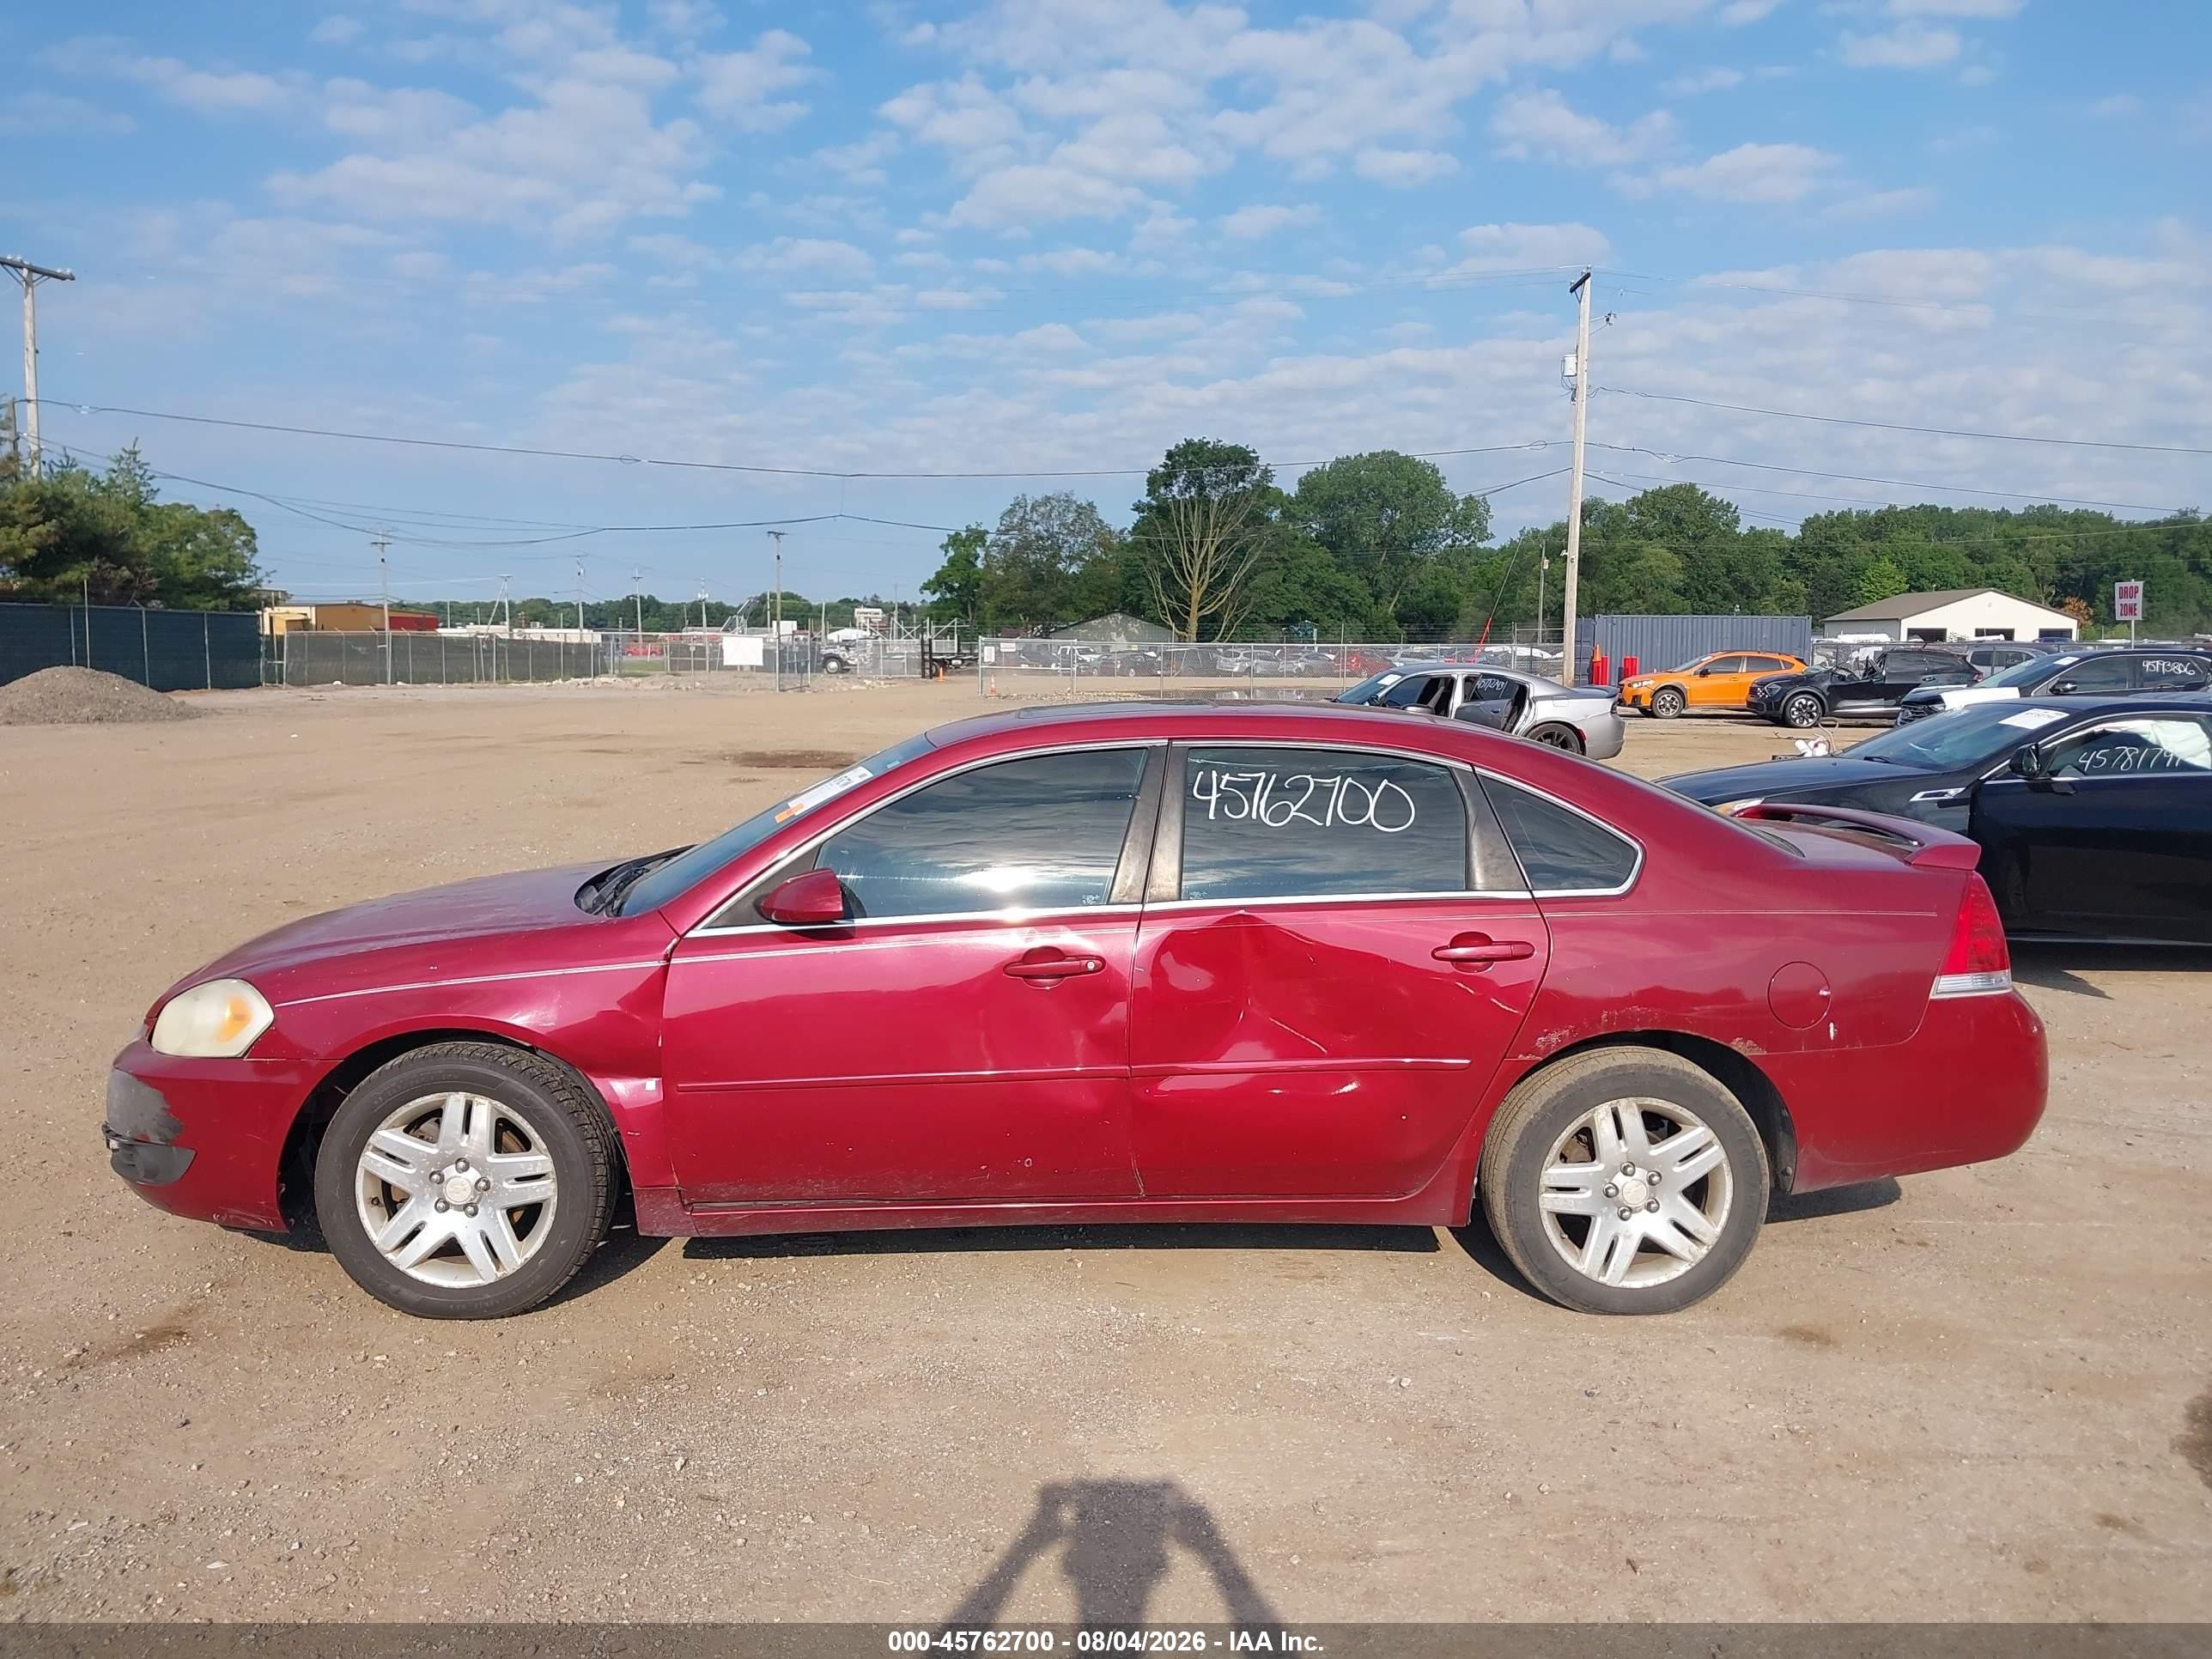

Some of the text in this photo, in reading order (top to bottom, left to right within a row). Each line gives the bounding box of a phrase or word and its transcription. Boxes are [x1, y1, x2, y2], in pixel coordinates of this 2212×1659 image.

[2118, 586, 2139, 599] DROP
[2119, 603, 2137, 617] ZONE
[1193, 770, 1416, 832] 45762700
